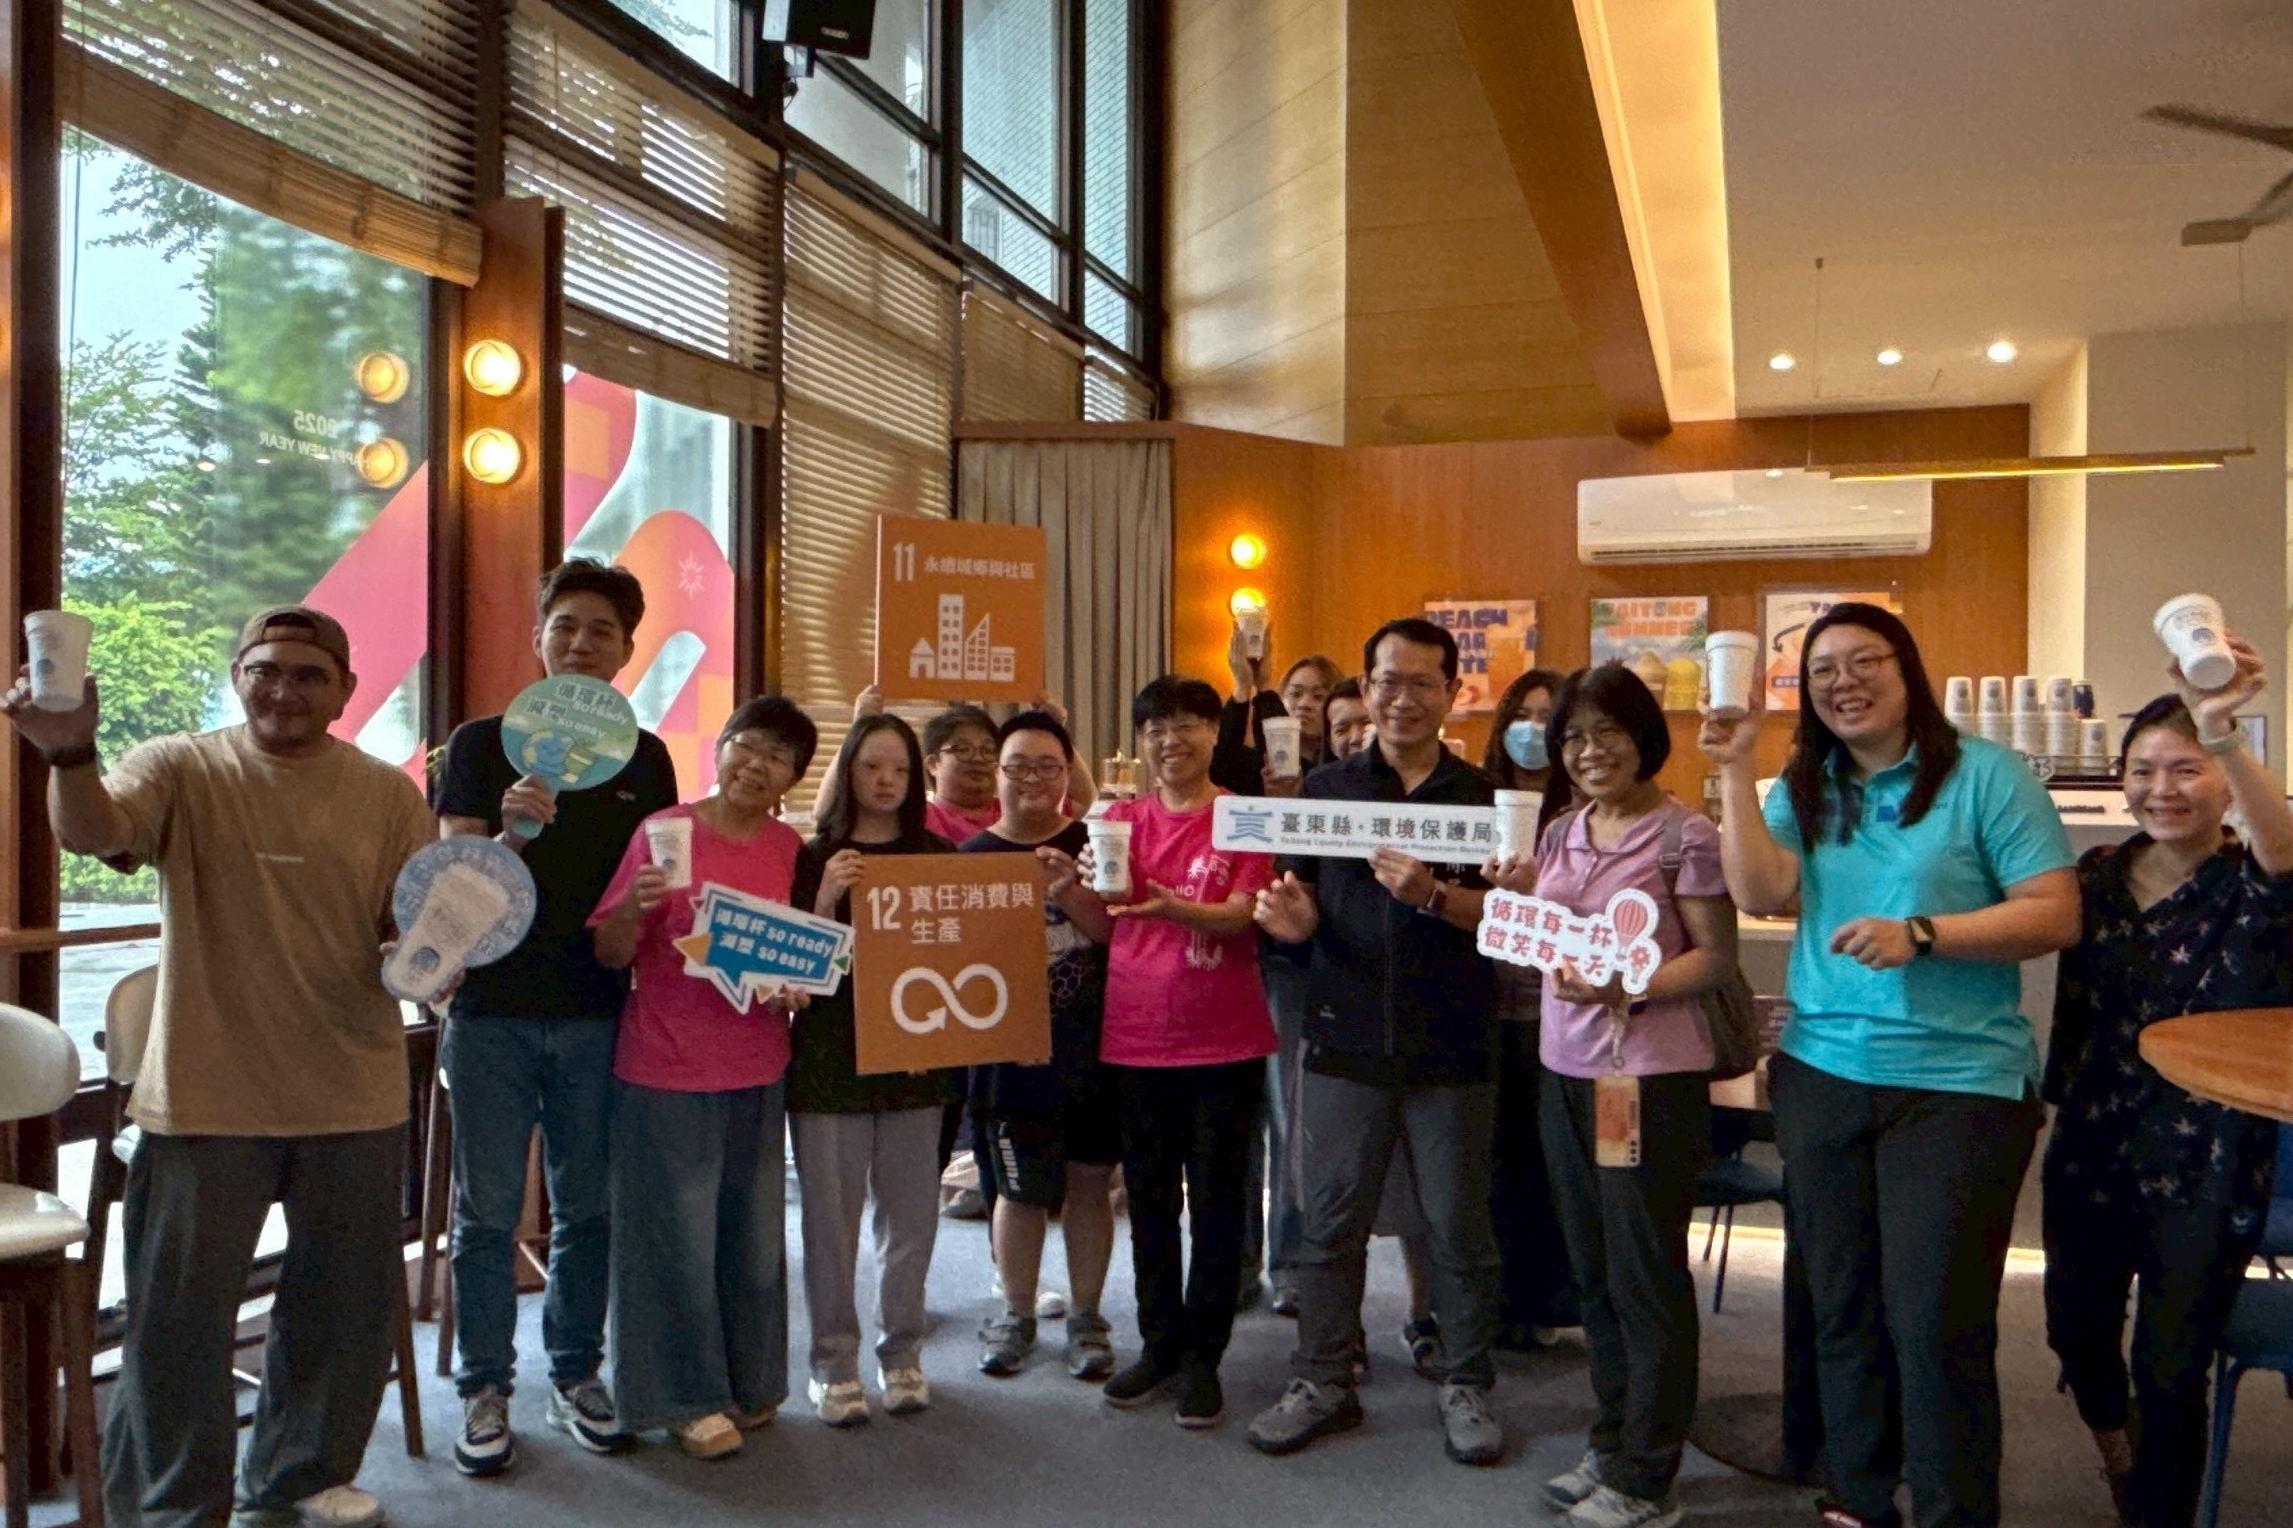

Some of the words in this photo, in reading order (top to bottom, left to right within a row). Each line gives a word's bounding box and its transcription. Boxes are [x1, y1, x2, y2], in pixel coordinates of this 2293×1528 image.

[893, 542, 915, 582] 11
[867, 885, 901, 930] 12
[910, 882, 1034, 912] 責任消費與
[767, 926, 786, 943] so
[787, 933, 833, 958] ready
[911, 917, 961, 944] 生產
[758, 946, 777, 962] so
[779, 952, 816, 975] easy
